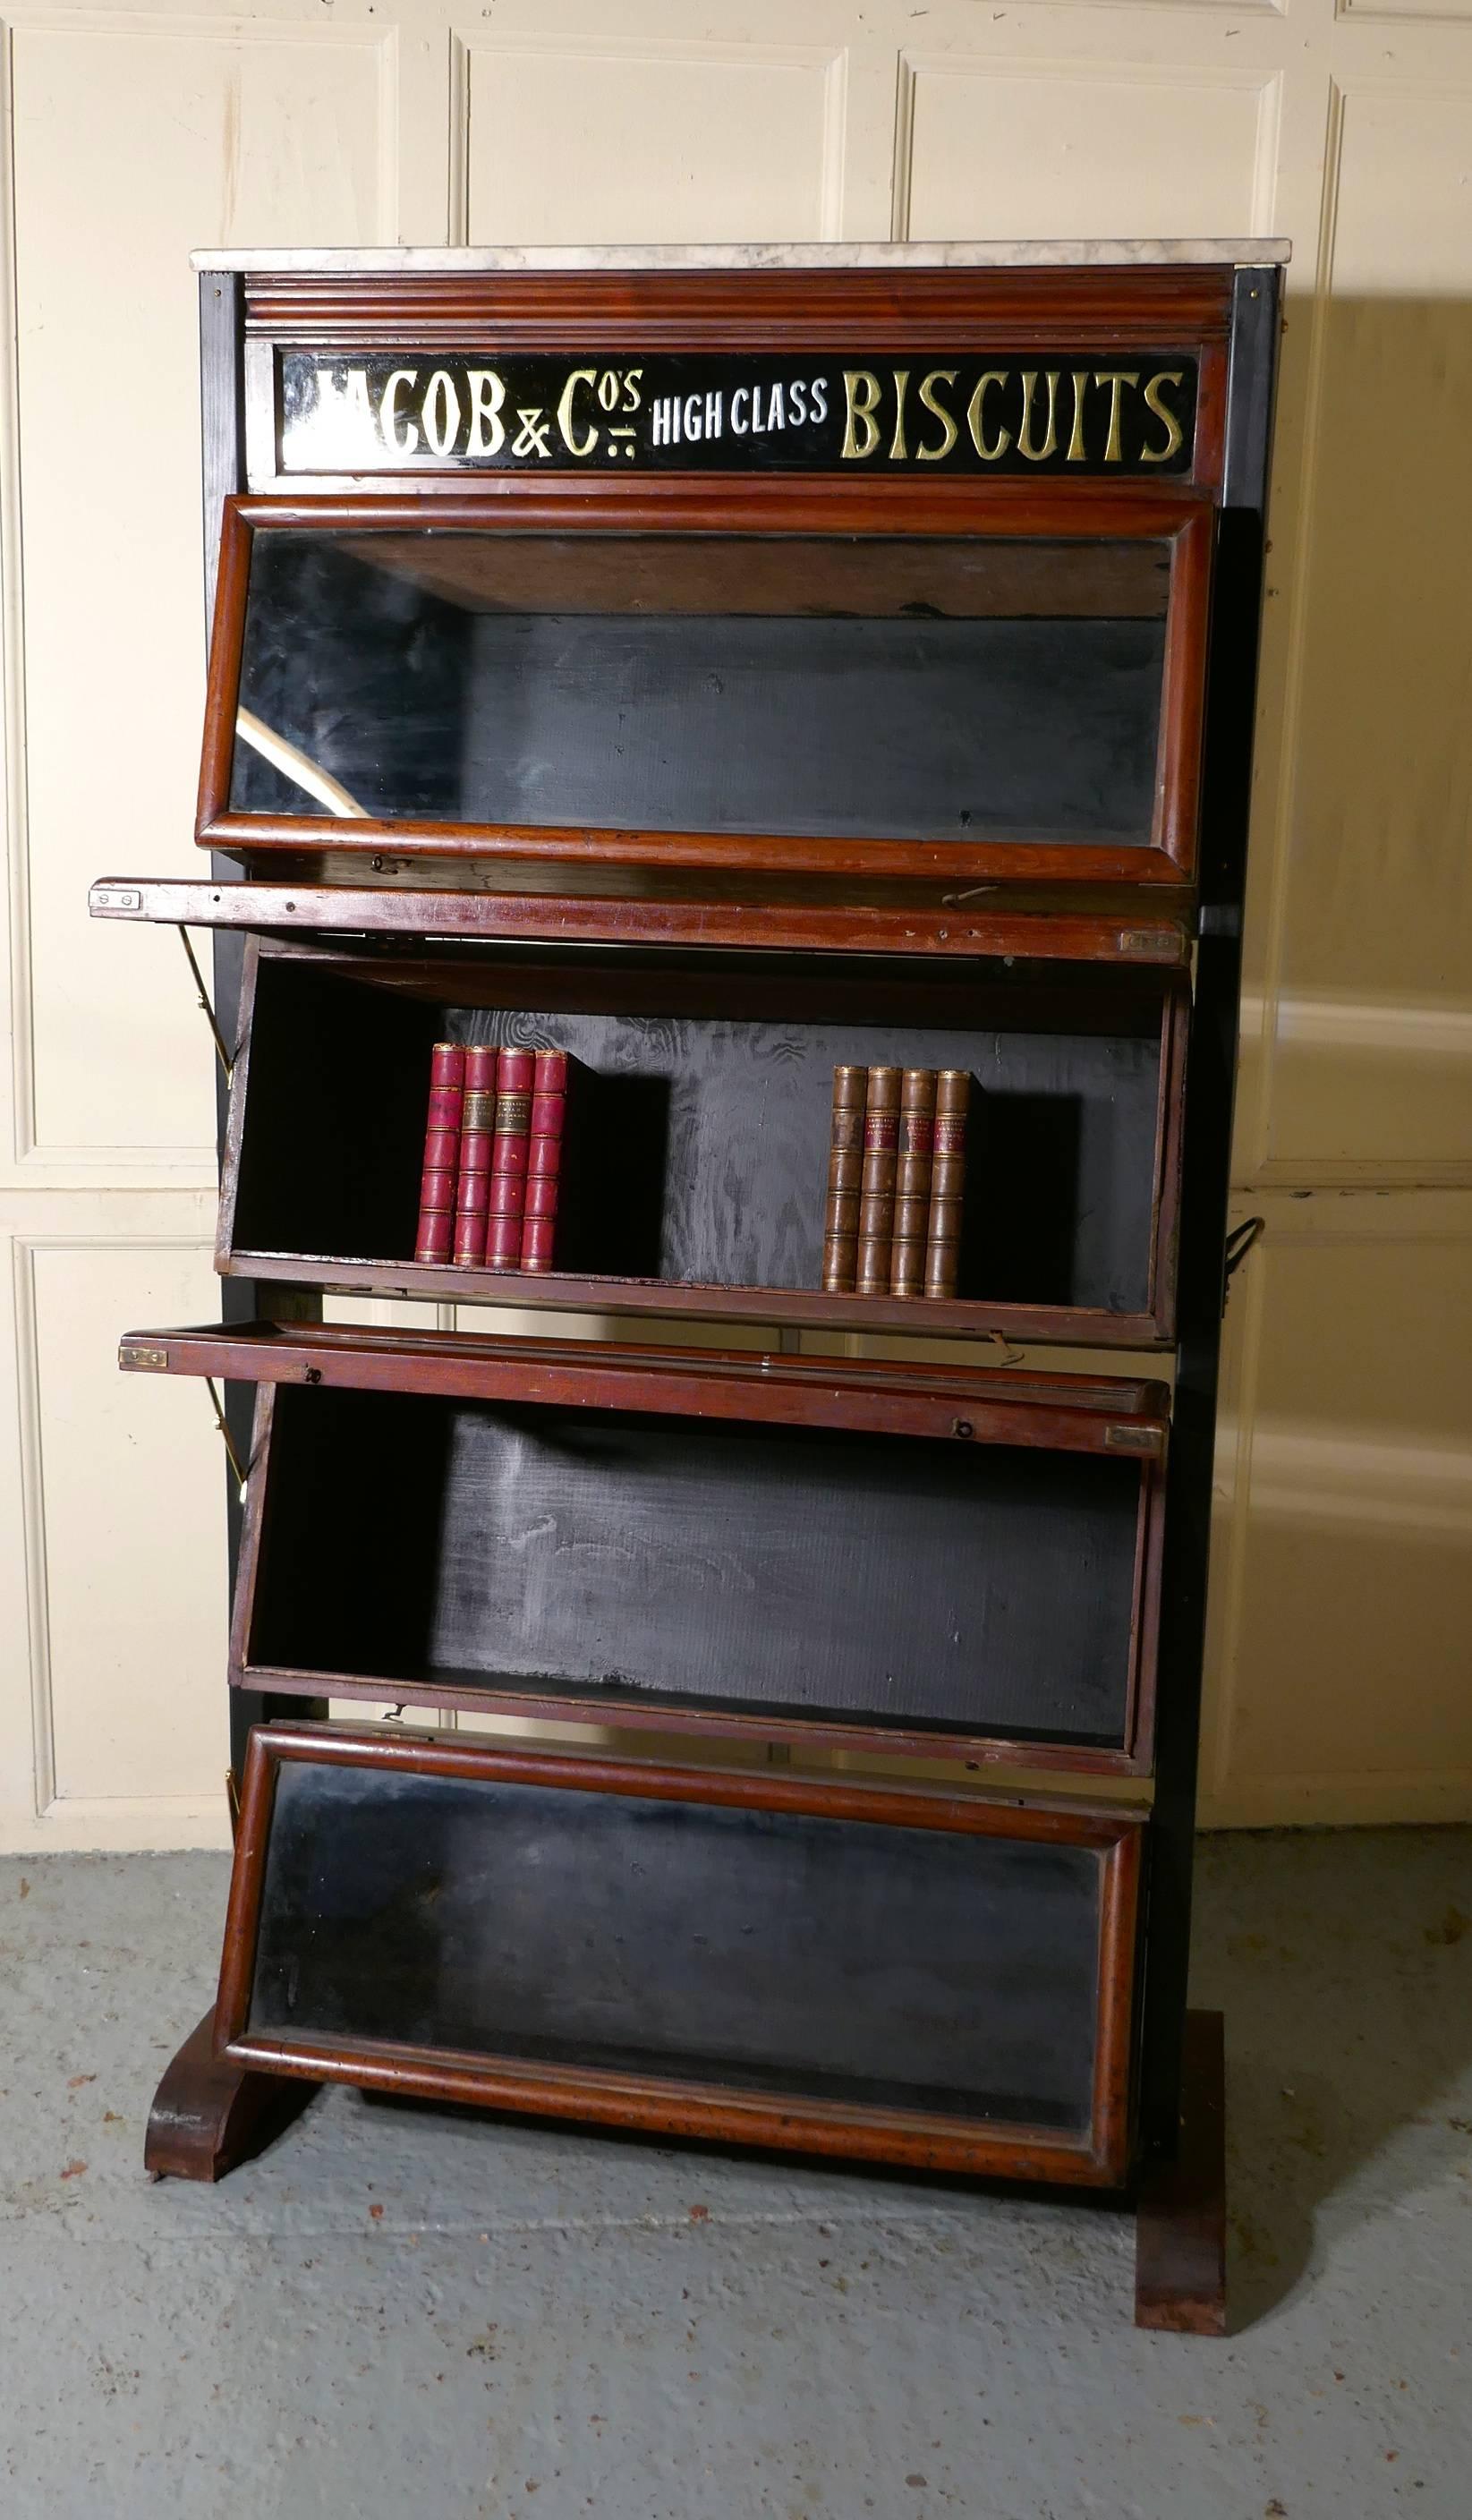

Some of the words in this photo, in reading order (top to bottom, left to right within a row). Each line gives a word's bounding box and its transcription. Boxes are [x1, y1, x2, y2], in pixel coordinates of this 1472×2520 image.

[511, 408, 553, 458] &
[652, 390, 723, 447] HIGH
[730, 377, 829, 435] CLASS
[839, 370, 1185, 462] BISCUITS
